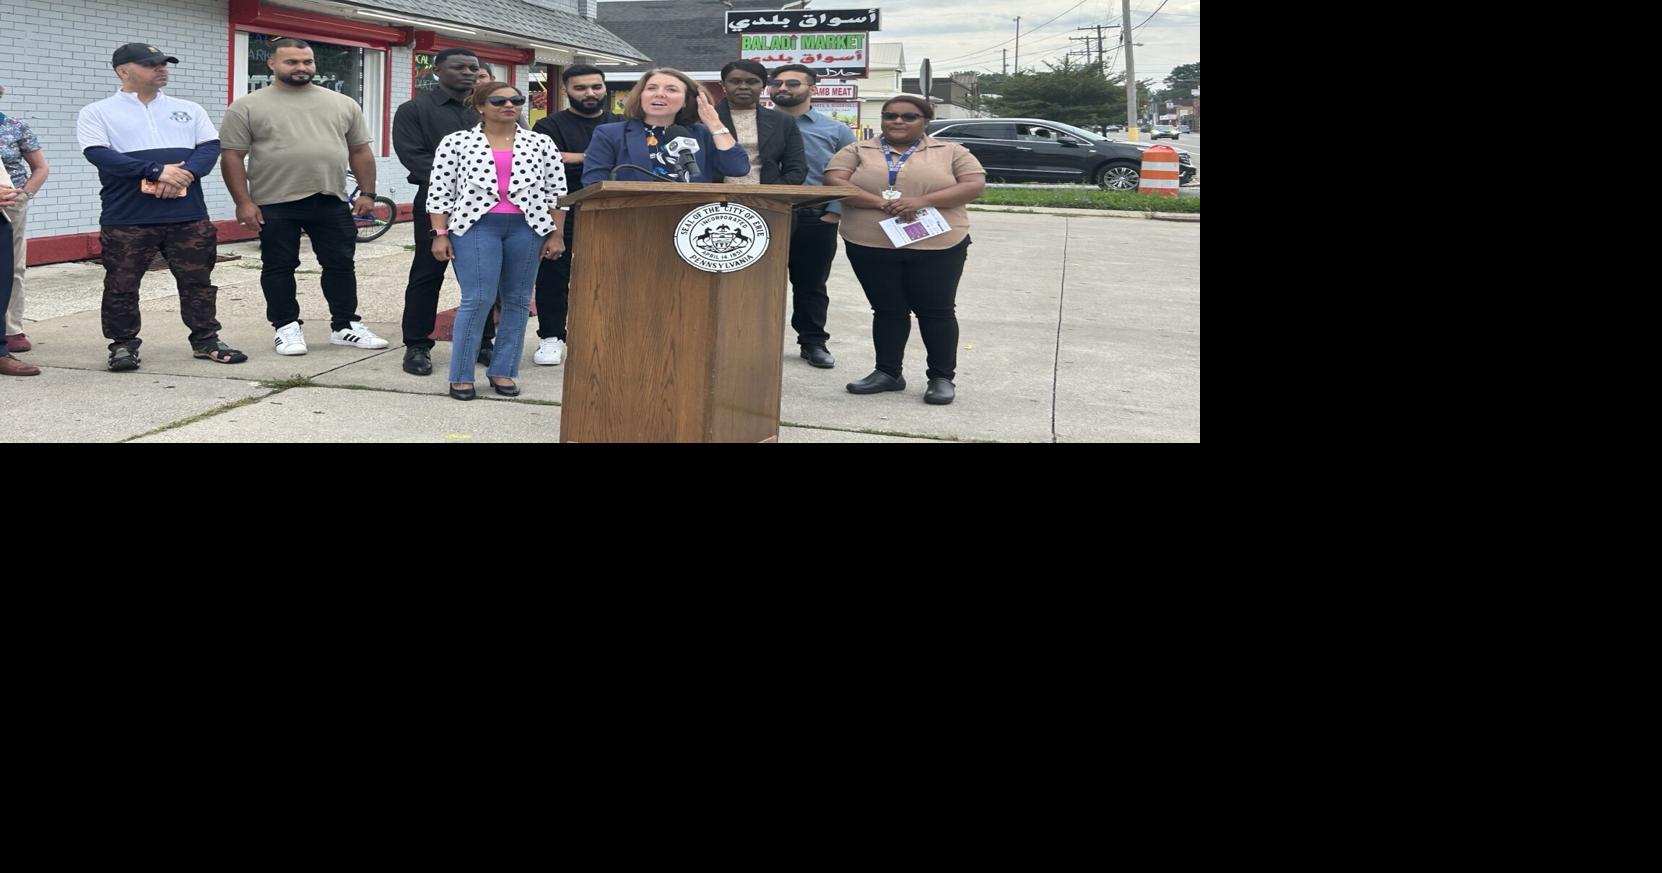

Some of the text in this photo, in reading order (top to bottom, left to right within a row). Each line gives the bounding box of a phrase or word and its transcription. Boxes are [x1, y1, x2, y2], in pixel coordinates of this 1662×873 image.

[728, 8, 876, 31] أسواق بلدي
[801, 34, 865, 50] MARKET
[801, 50, 863, 64] أسواق
[832, 87, 852, 96] MEAT
[681, 206, 765, 237] SEAL OF THE CITY OF ERIE
[700, 215, 748, 229] INCORPORATED
[689, 254, 754, 269] PENNSYLVANIA
[701, 250, 720, 260] APRIL
